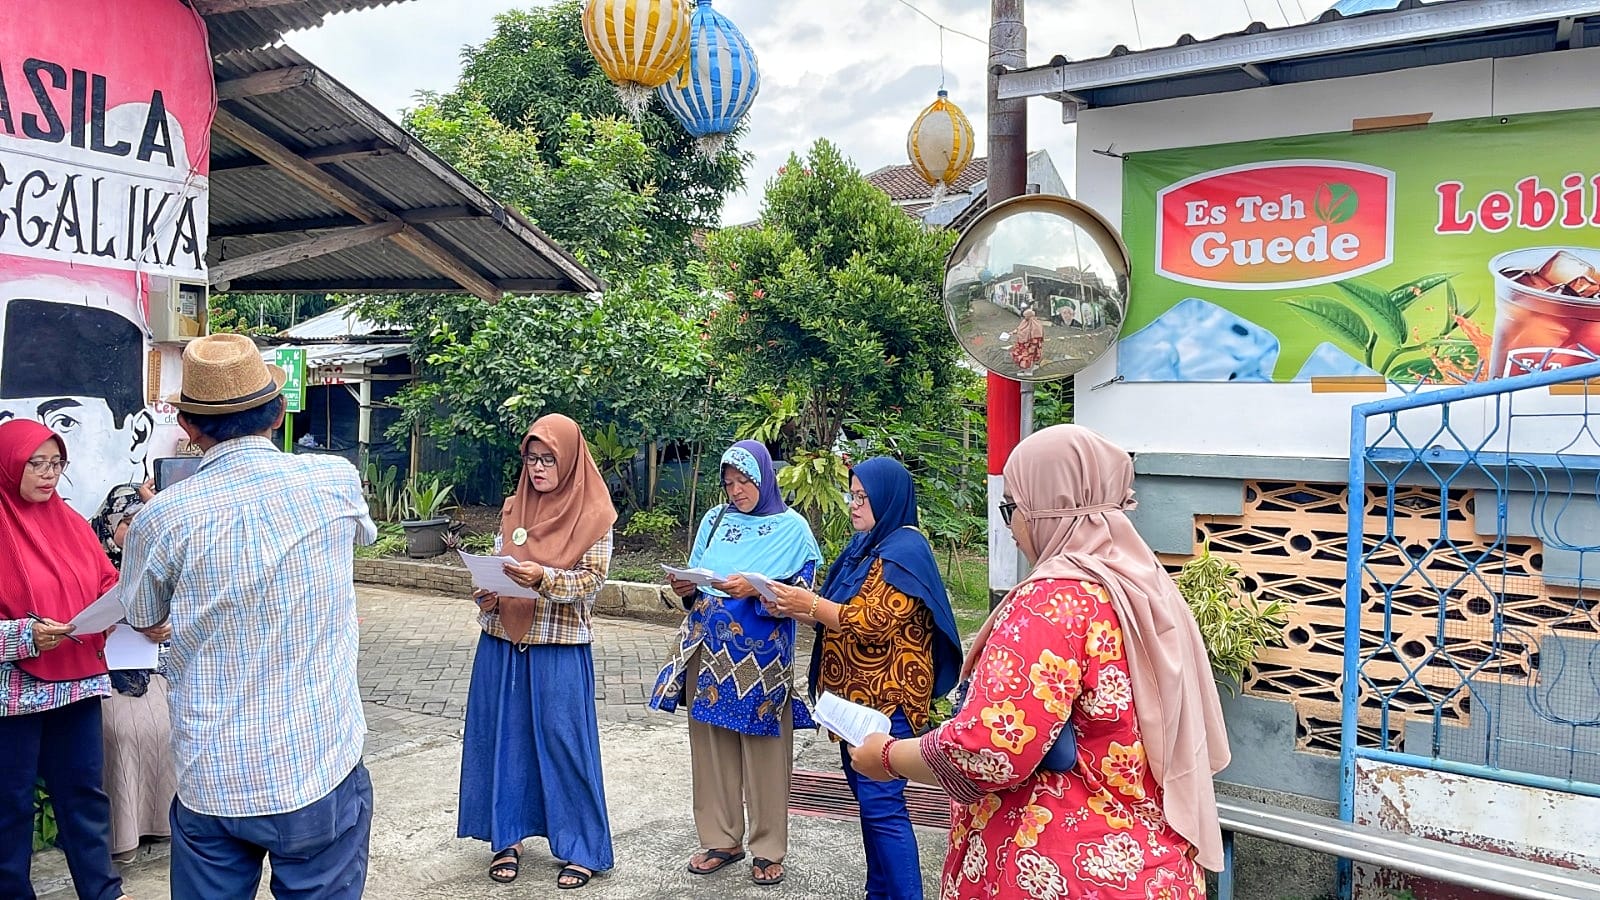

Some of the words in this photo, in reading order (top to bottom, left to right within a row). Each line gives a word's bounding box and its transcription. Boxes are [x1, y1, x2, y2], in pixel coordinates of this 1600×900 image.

[0, 160, 204, 270] GALIKA
[1185, 200, 1227, 226] Es
[1237, 193, 1306, 223] Teh
[1434, 174, 1600, 234] Lebi
[1190, 226, 1360, 268] Guede
